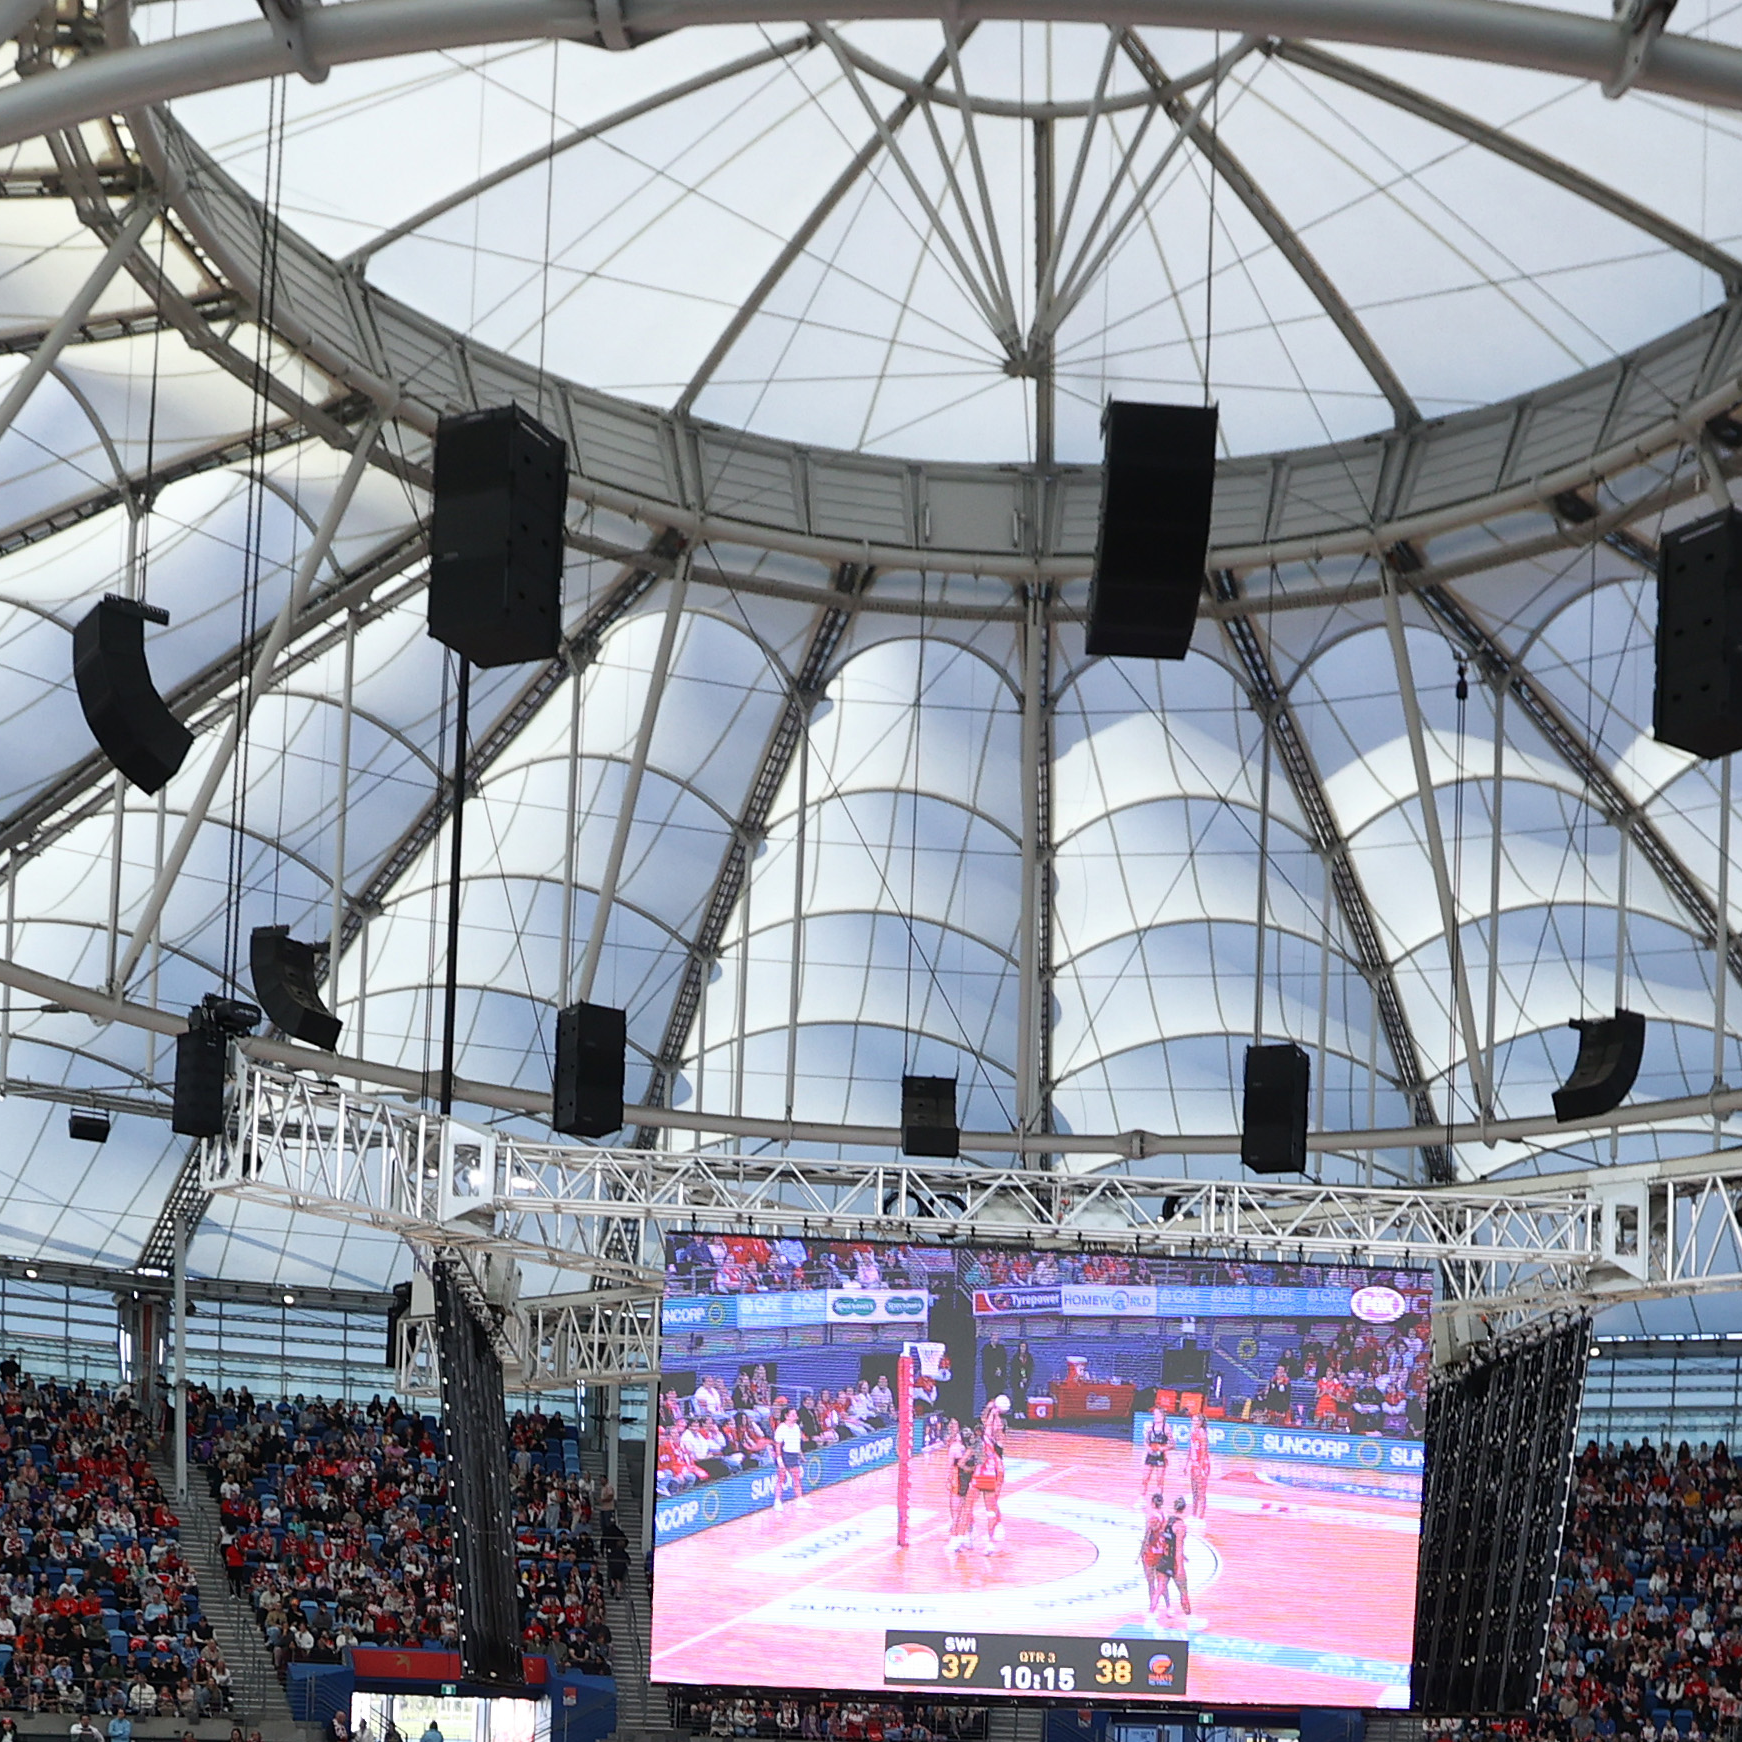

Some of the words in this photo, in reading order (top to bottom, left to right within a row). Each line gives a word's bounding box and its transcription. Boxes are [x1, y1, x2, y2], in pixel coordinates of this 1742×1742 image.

[848, 1437, 893, 1466] SUNCORP
[1262, 1434, 1350, 1459] SUNCORP
[944, 1637, 976, 1652] SWI
[1019, 1650, 1041, 1662] QTR
[1045, 1652, 1056, 1663] 3
[1100, 1642, 1128, 1658] GIA
[941, 1654, 978, 1679] 37
[1000, 1666, 1075, 1691] 10:15
[1095, 1659, 1132, 1684] 38
